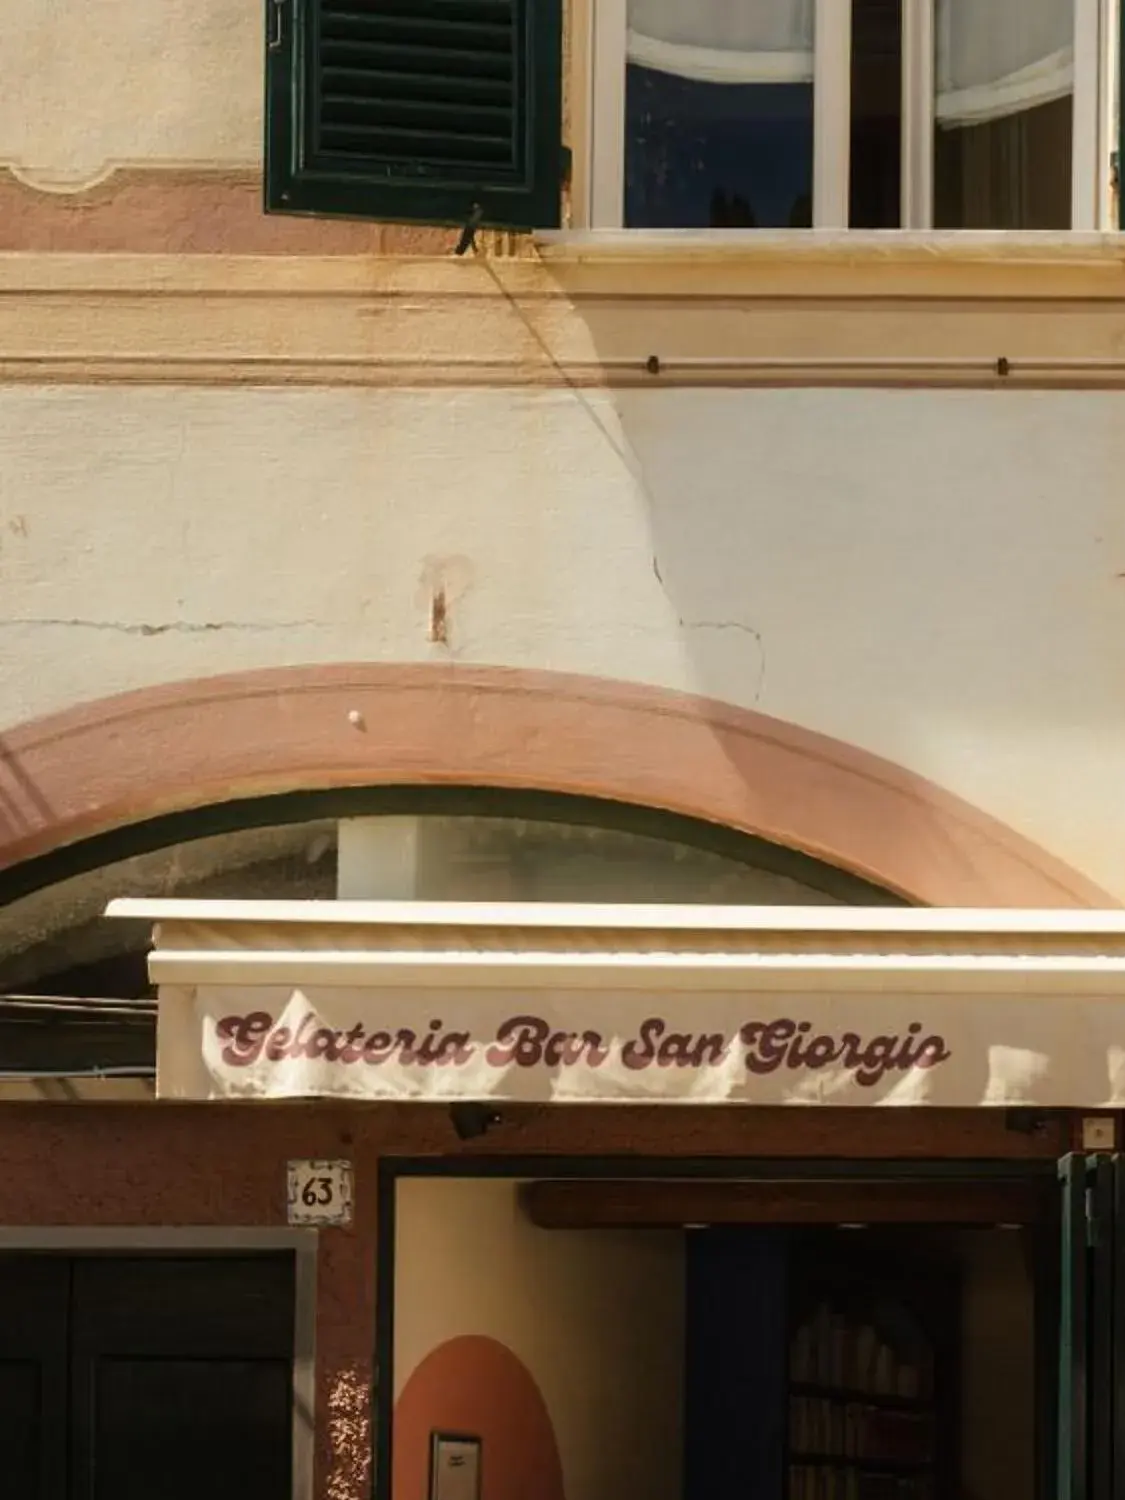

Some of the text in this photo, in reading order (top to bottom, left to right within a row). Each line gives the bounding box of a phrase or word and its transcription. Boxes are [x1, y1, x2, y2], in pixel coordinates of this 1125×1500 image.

[216, 1011, 951, 1087] Gelateria Bar San Giorgio
[302, 1177, 333, 1206] 63
